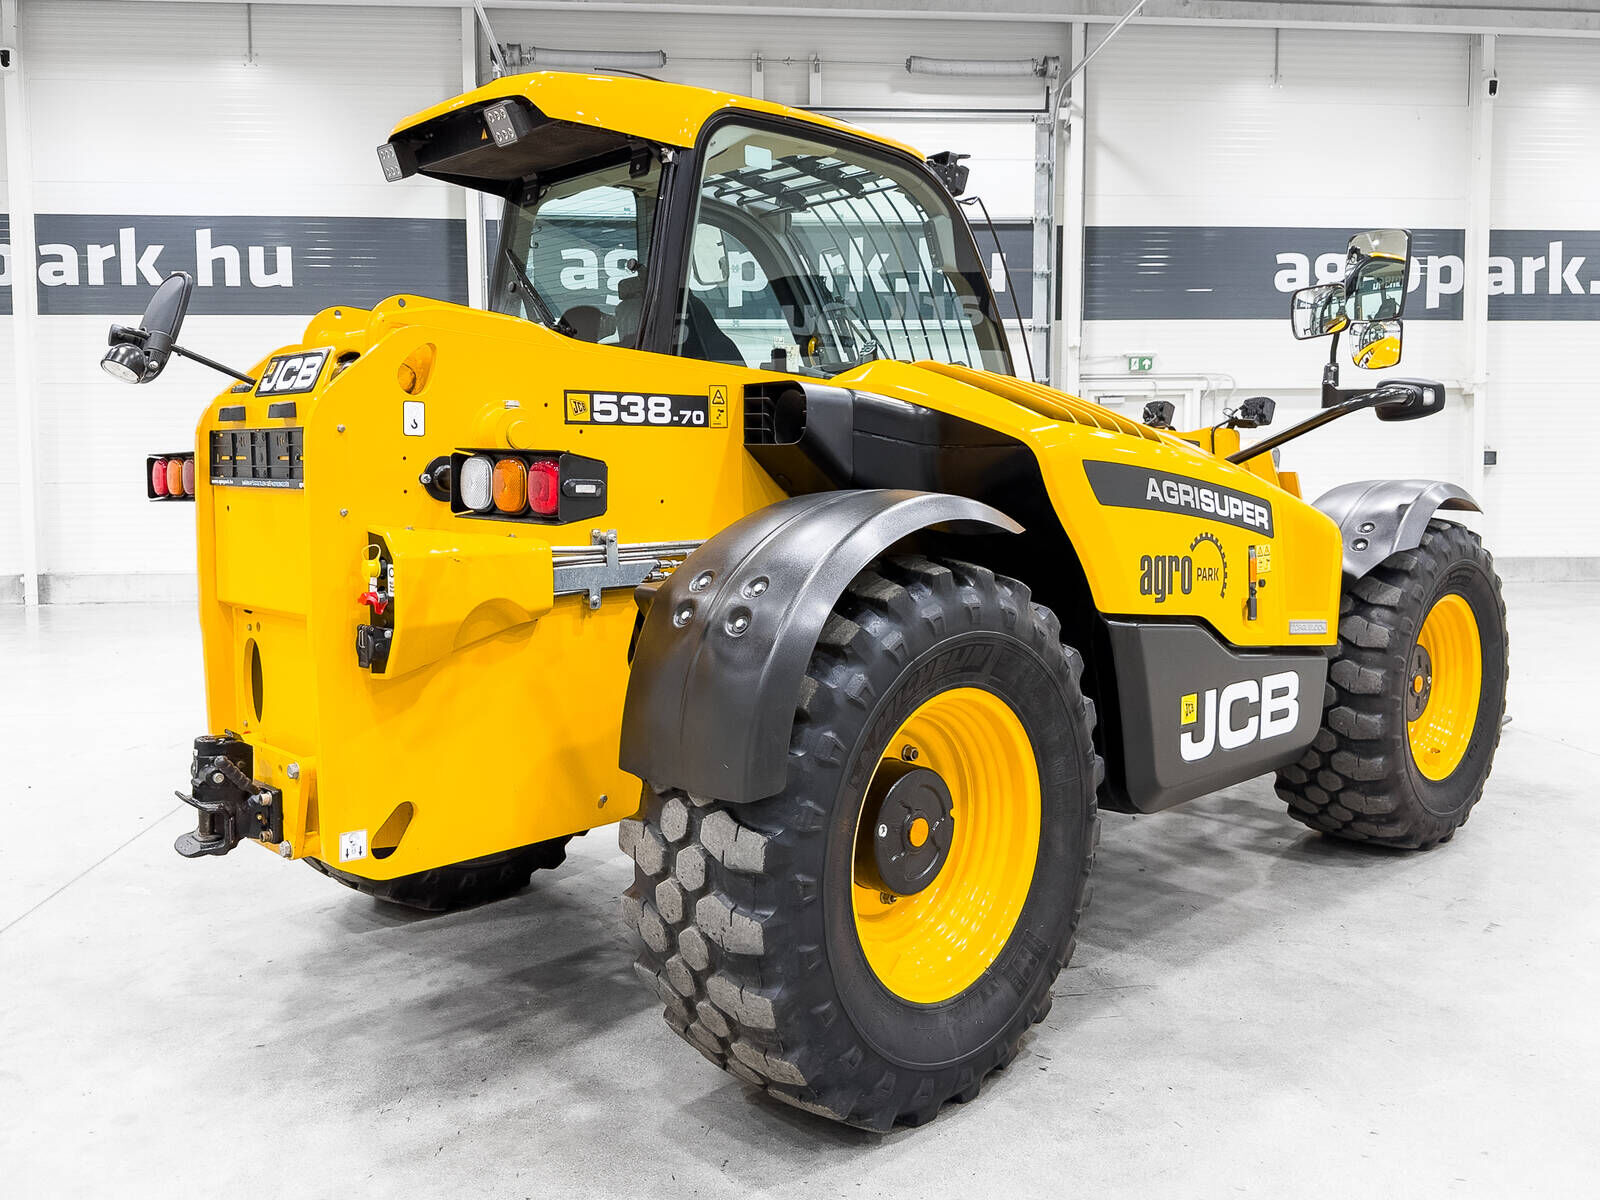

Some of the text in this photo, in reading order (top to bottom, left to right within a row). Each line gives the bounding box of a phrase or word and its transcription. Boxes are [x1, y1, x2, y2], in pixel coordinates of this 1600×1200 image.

[260, 356, 323, 392] JCB
[592, 394, 705, 424] 538-70
[1146, 477, 1269, 530] AGRISUPER
[1140, 554, 1219, 603] agro PARK
[1180, 670, 1300, 761] JCB
